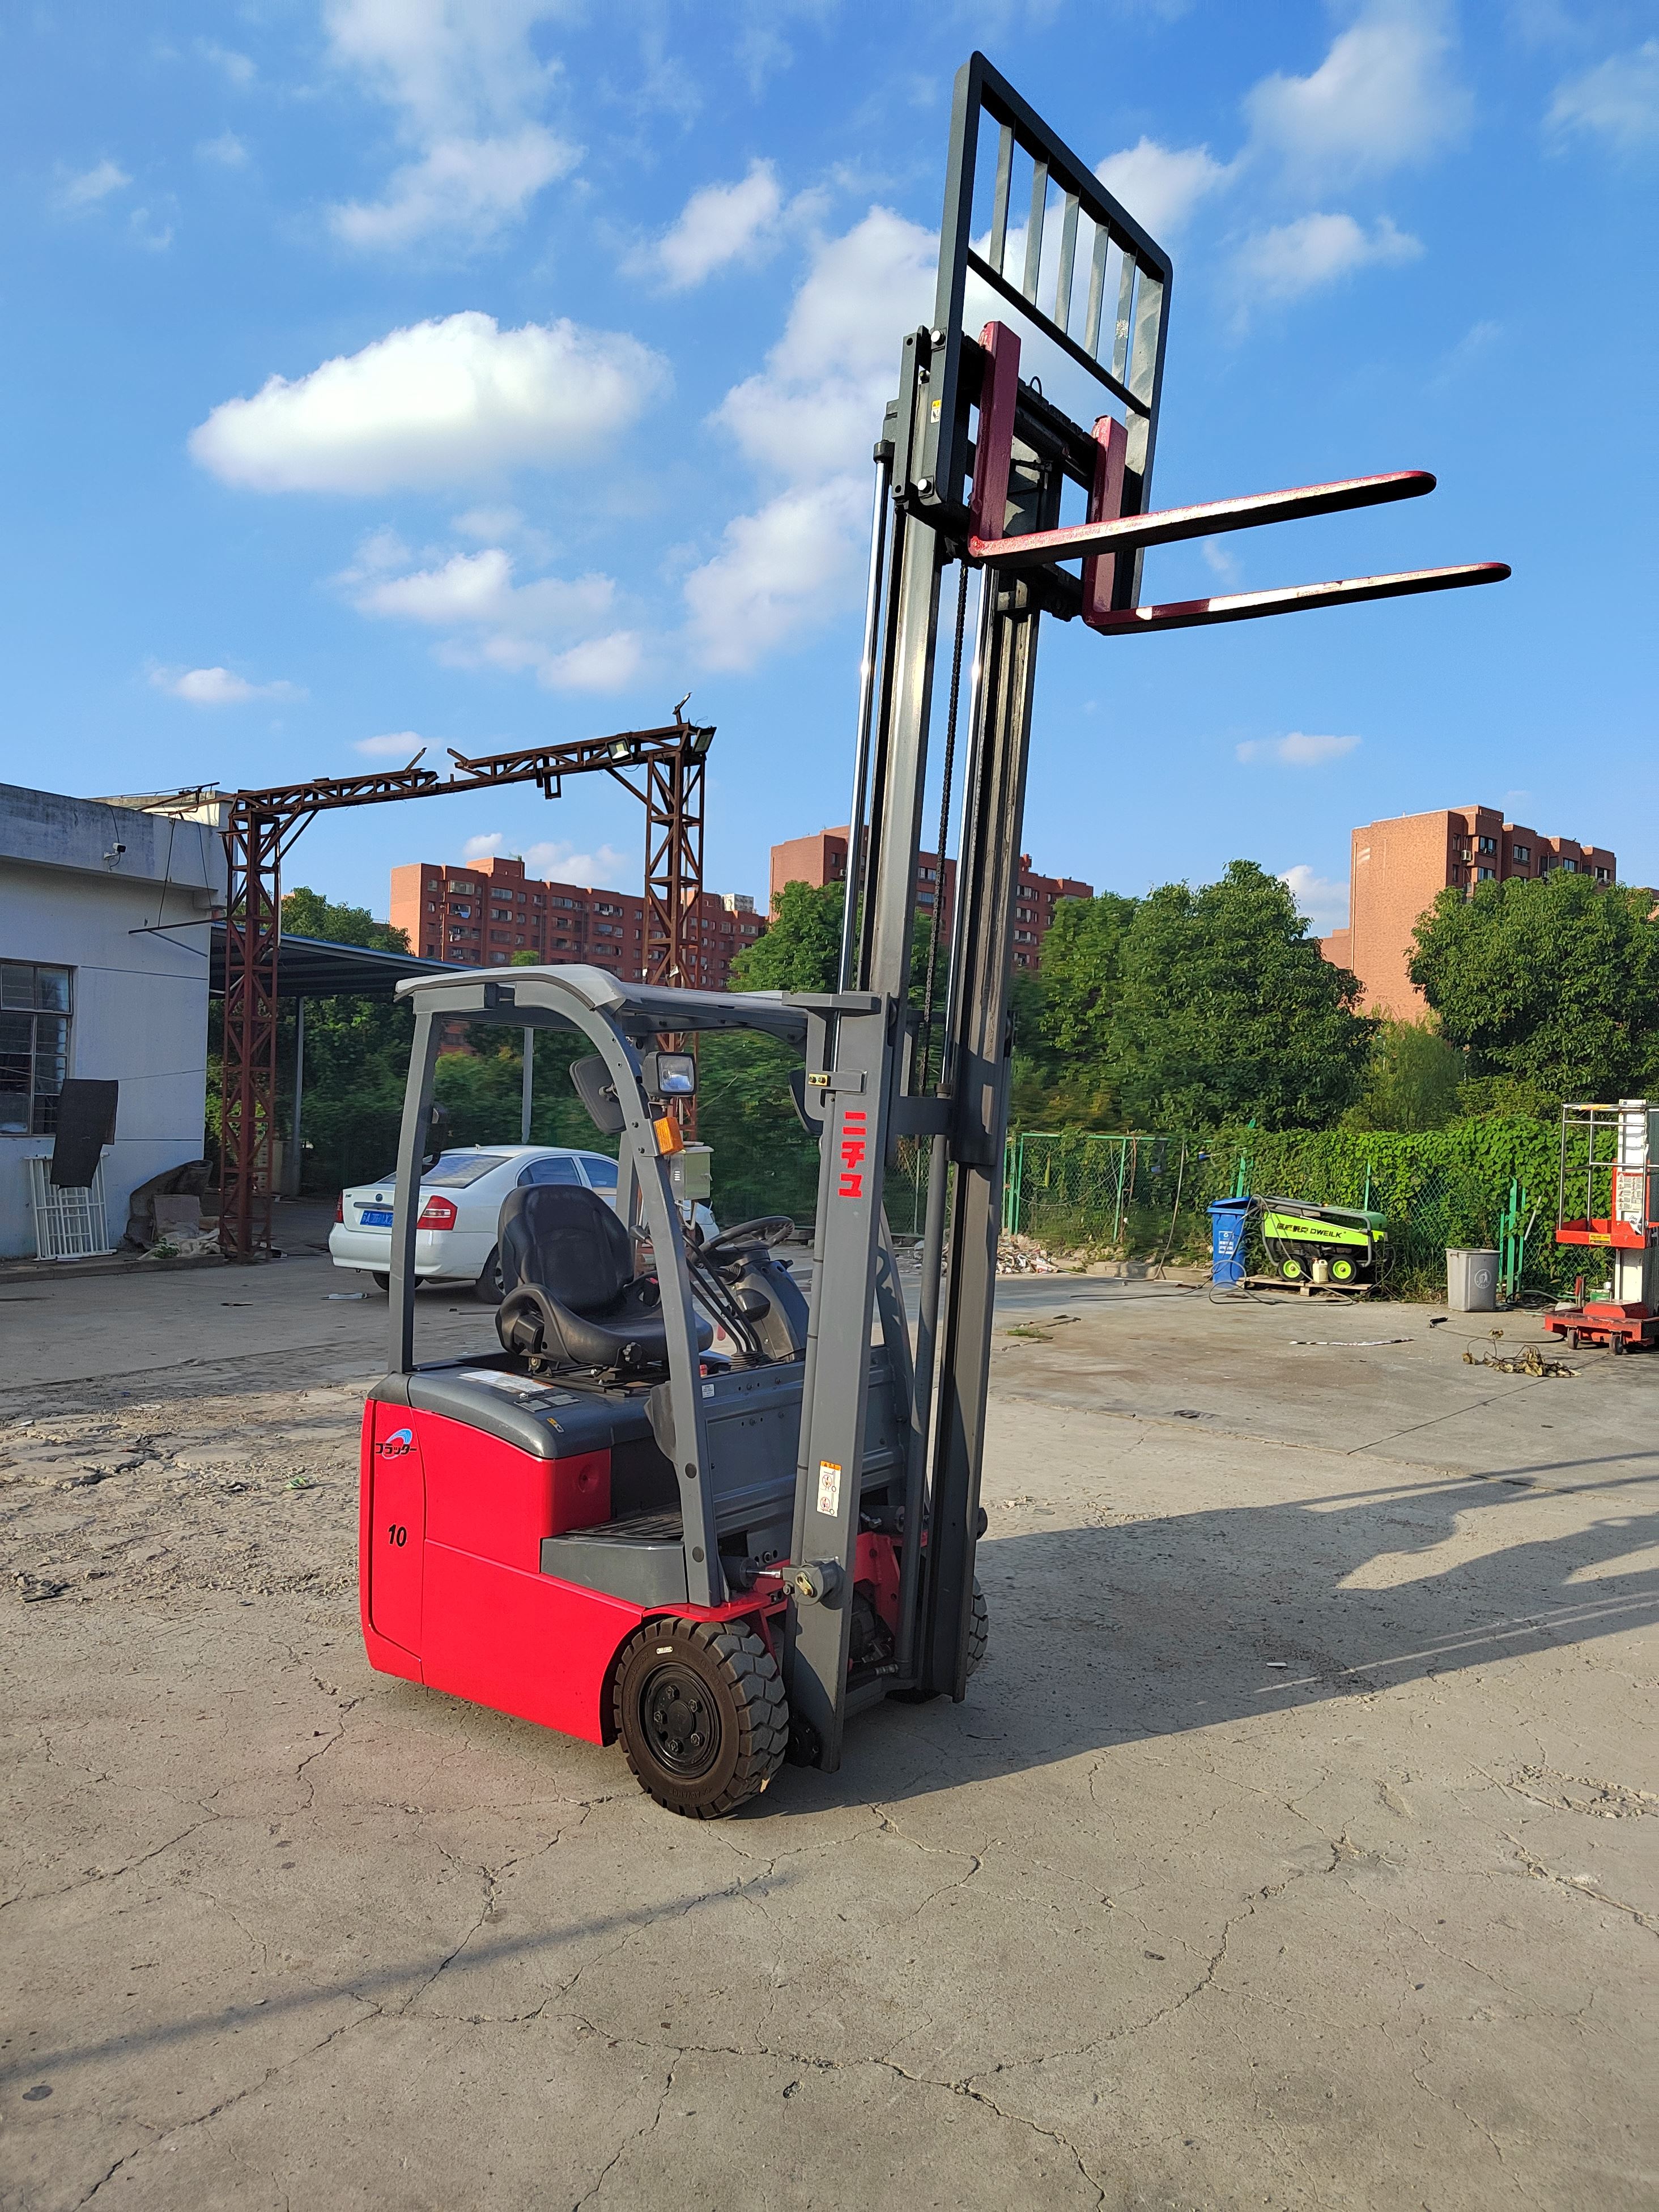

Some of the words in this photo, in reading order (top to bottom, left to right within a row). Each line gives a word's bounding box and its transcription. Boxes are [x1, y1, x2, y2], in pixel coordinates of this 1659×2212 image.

[838, 1111, 867, 1198] ニチユ
[389, 1524, 407, 1547] 10
